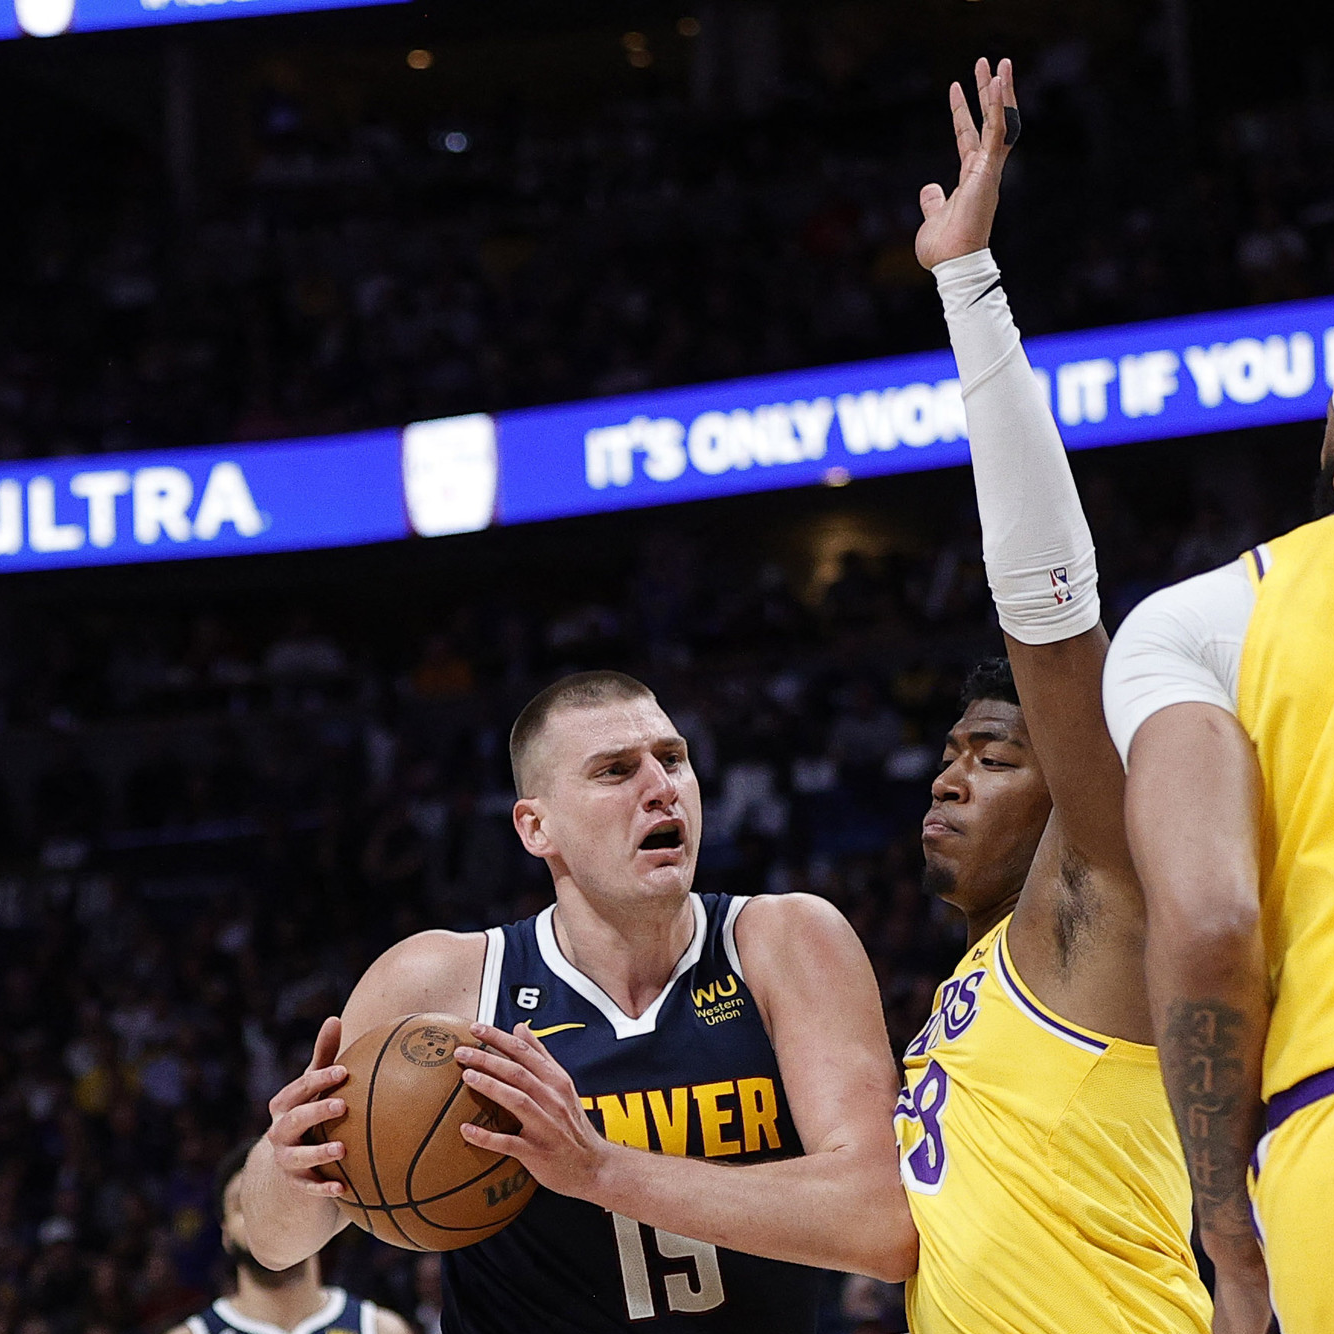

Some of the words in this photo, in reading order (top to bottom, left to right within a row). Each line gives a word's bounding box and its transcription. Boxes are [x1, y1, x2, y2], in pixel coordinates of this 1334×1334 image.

[583, 416, 687, 490] IT'S
[687, 396, 836, 475] ONLY
[835, 378, 971, 455] WOR
[1057, 357, 1117, 426] IT
[1118, 349, 1180, 418] IF
[1184, 331, 1316, 408] YOU
[517, 986, 542, 1010] 6
[690, 974, 738, 1008] WU
[694, 998, 745, 1018] Western
[705, 1009, 741, 1026] Union
[579, 1077, 783, 1158] NVER
[605, 1207, 725, 1320] 15
